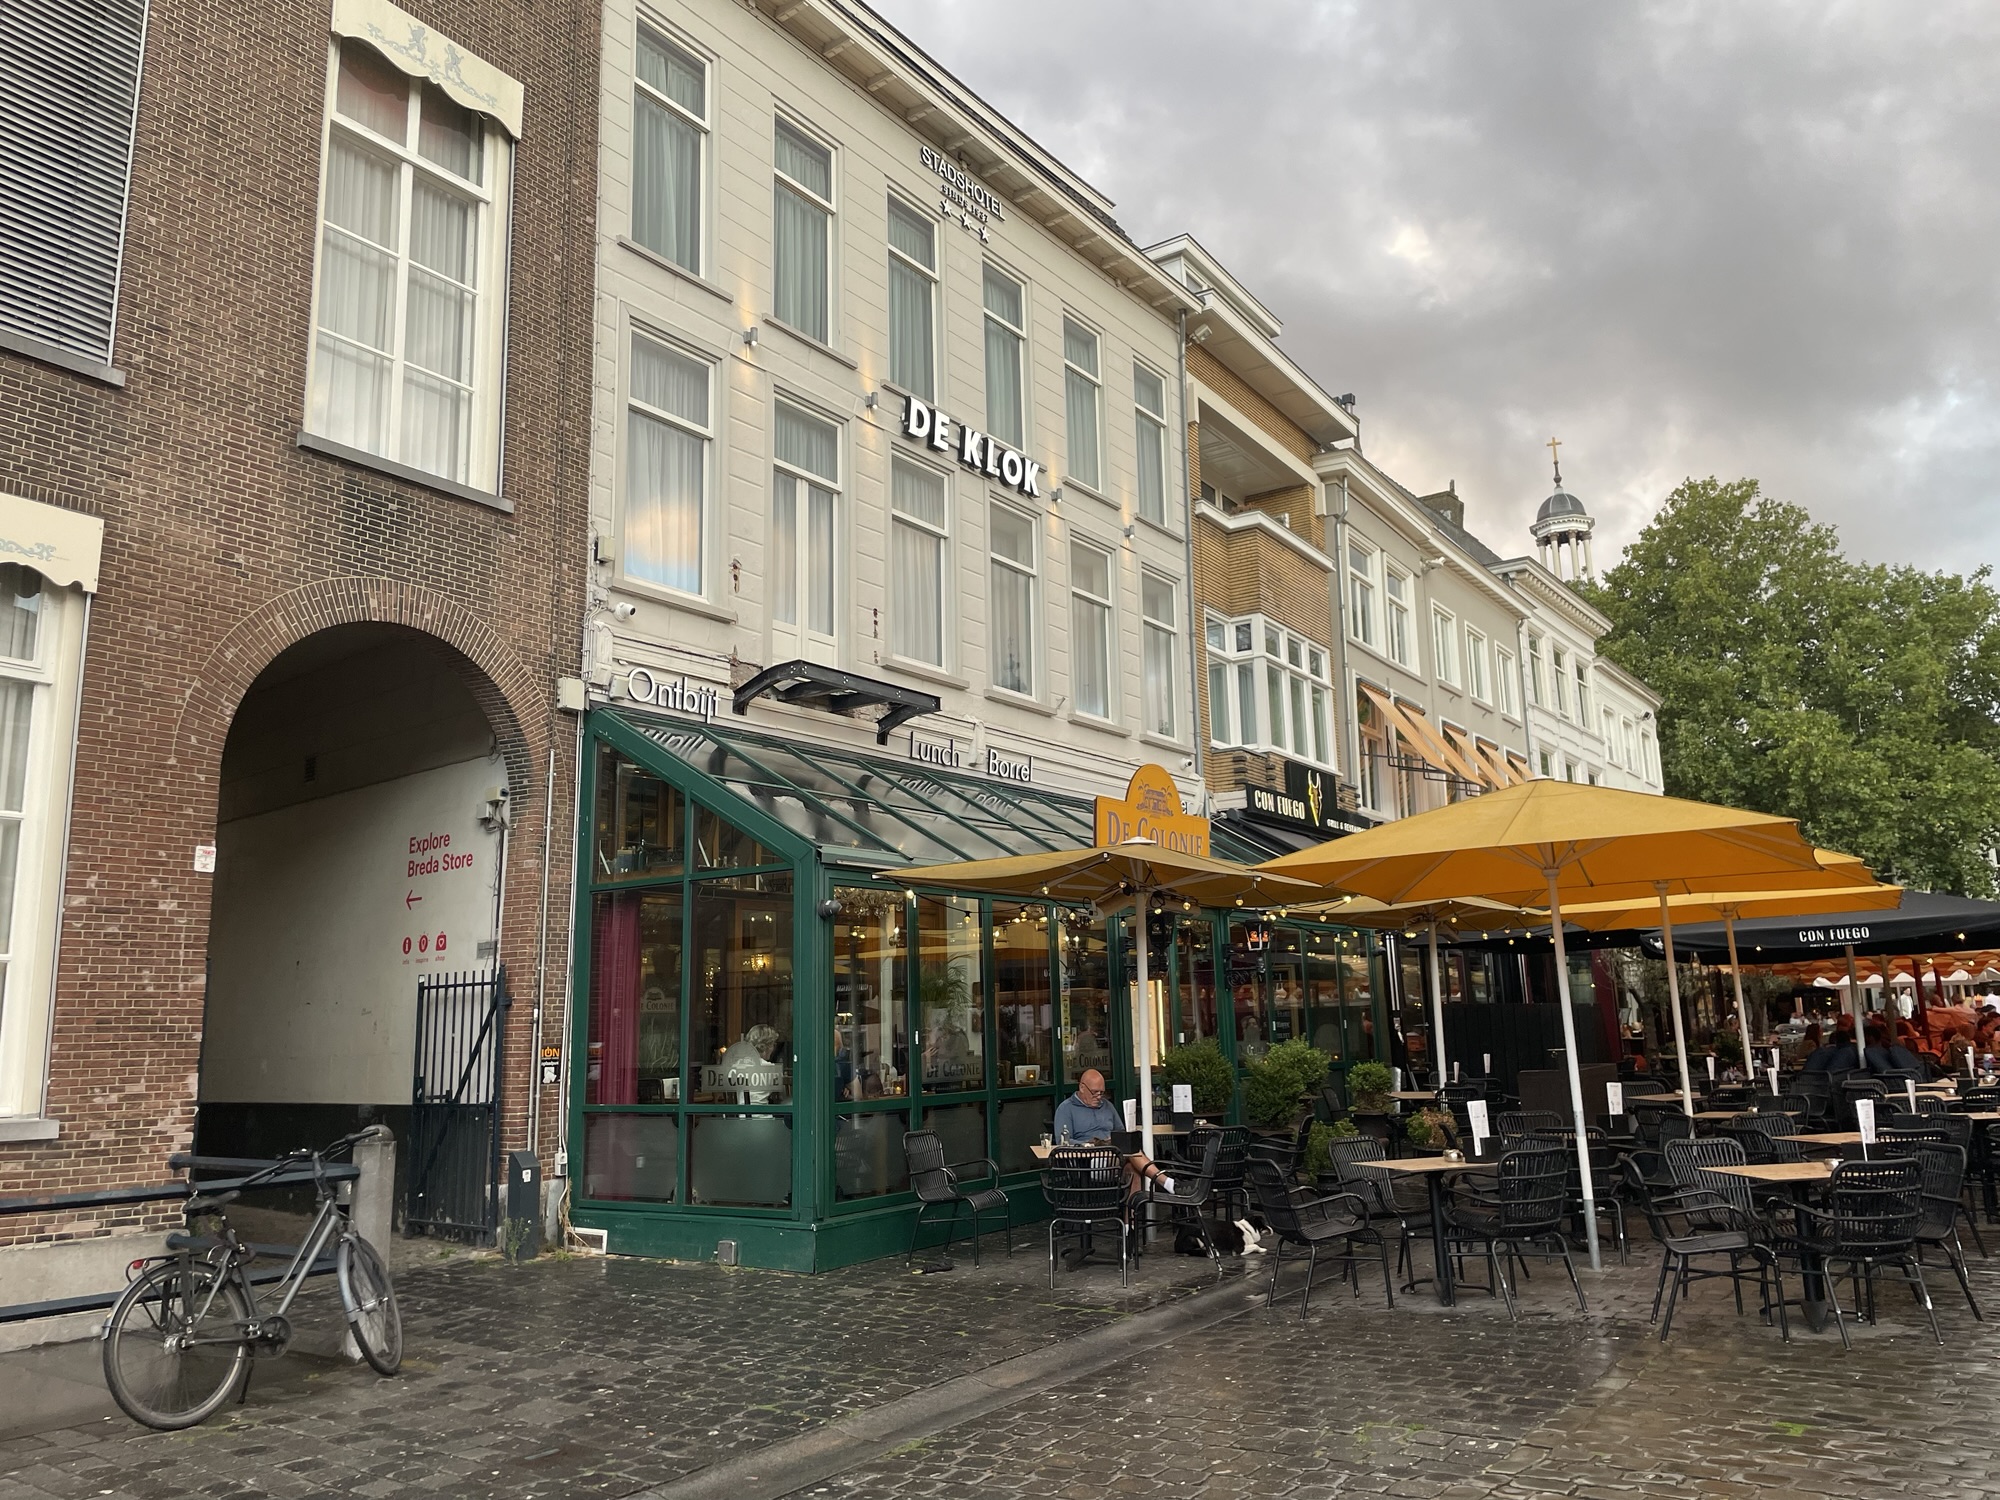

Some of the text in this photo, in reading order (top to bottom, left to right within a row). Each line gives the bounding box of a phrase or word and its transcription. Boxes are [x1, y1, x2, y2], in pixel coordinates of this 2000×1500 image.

[920, 146, 1006, 222] STADSHOTEL
[904, 396, 1040, 498] DE KLOK
[627, 667, 721, 723] Ontbijt
[909, 730, 1034, 783] Lunch Borrel
[1254, 789, 1275, 813] CON
[409, 832, 450, 856] Explore
[407, 853, 474, 878] Breda Store
[1799, 926, 1870, 943] CON FUEGO
[707, 1069, 780, 1087] DE COLONIE
